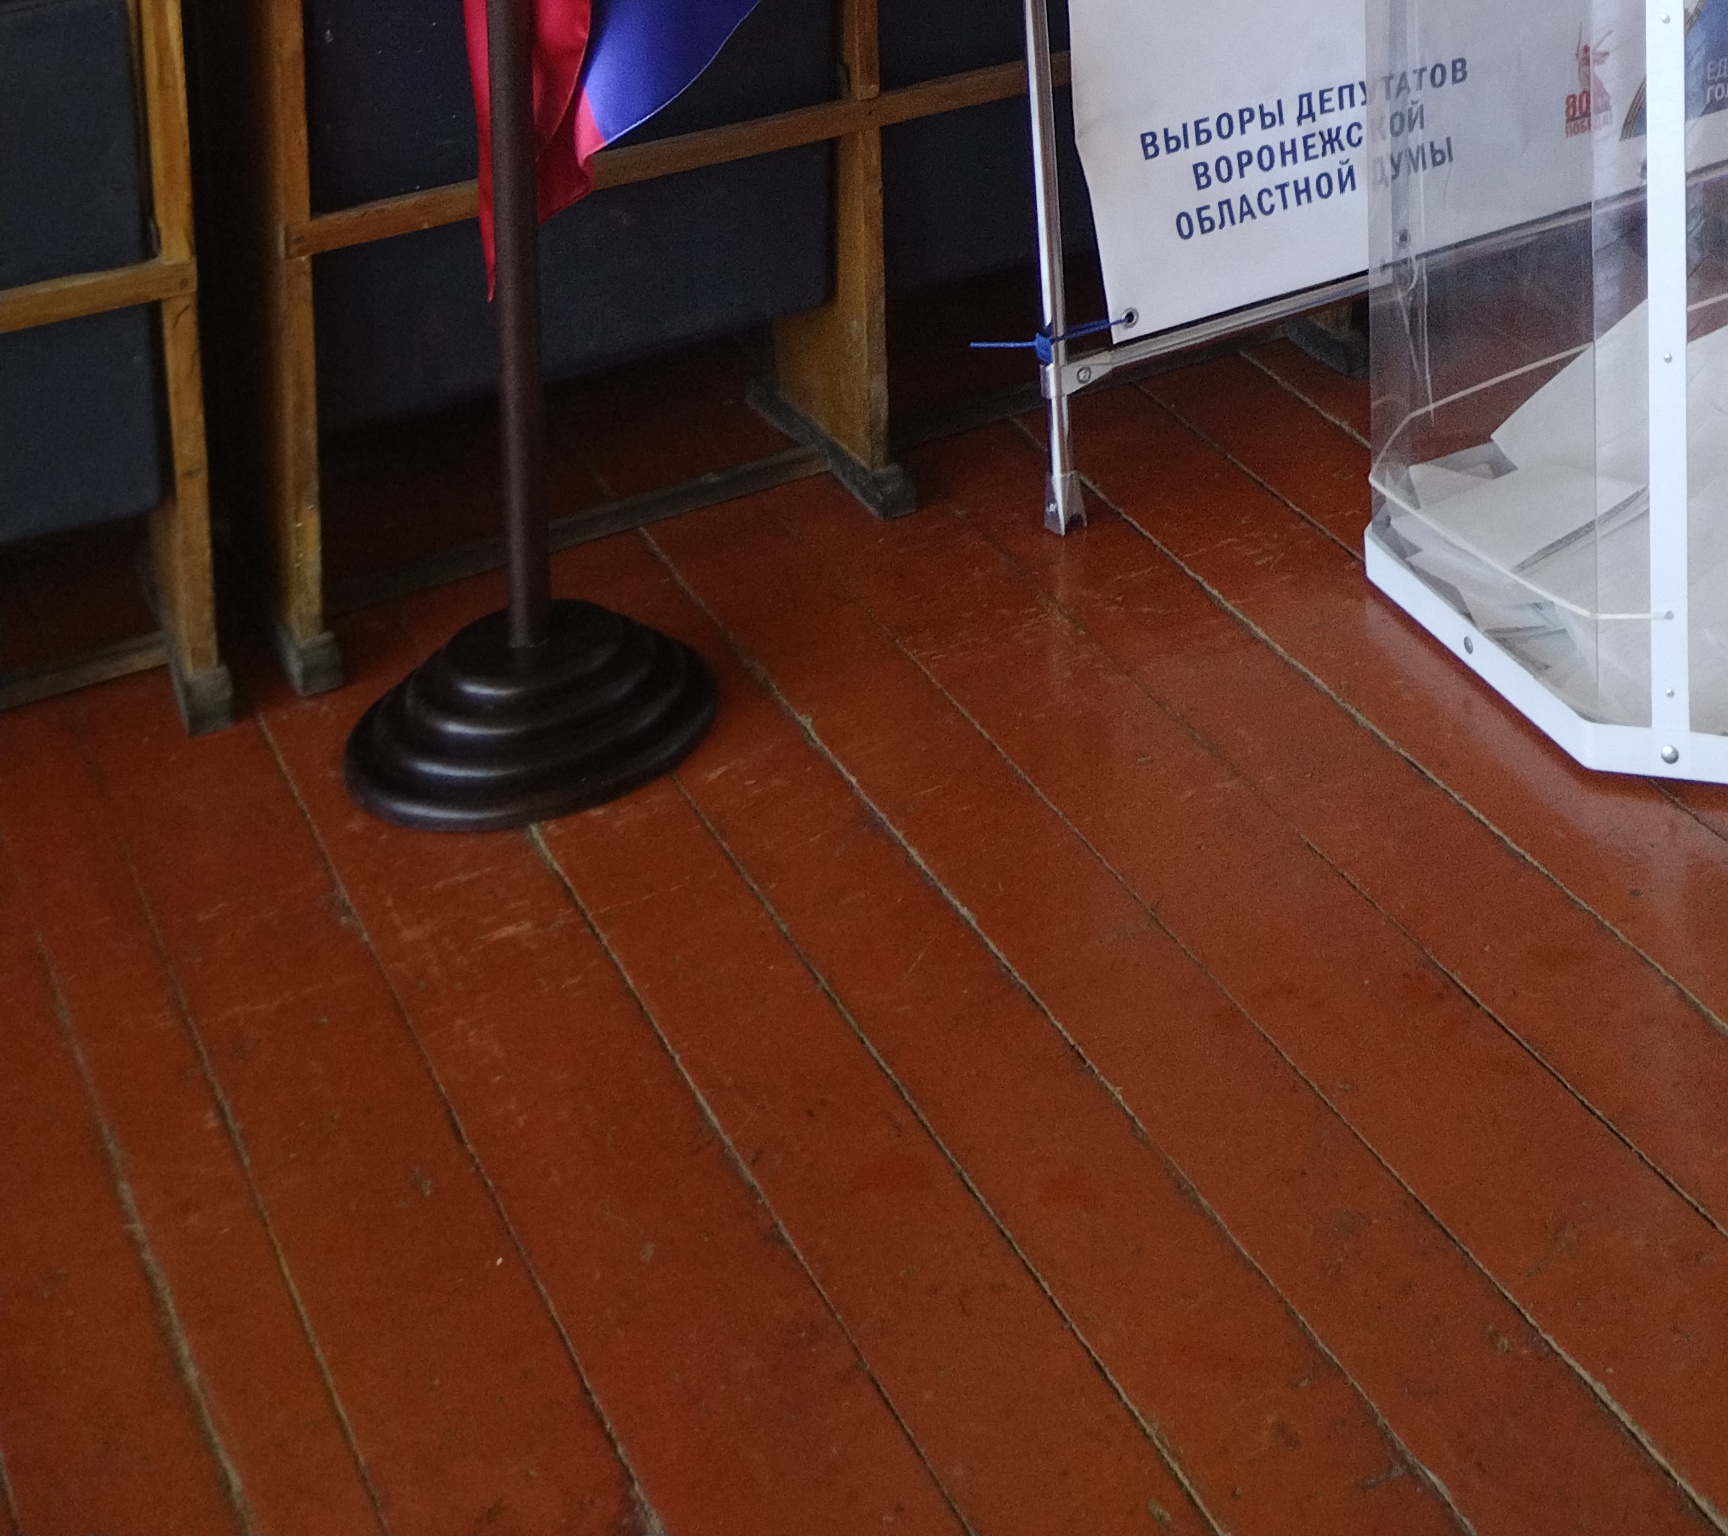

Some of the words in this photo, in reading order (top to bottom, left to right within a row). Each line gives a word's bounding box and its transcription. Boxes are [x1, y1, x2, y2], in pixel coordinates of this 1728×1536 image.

[1140, 98, 1285, 161] ВЫБОРЫ
[1297, 57, 1469, 127] ДЕПУТАТОВ
[1192, 97, 1426, 191] ВОРОНЕЖСКОЙ
[1175, 157, 1357, 240] ОБЛАСТНОЙ
